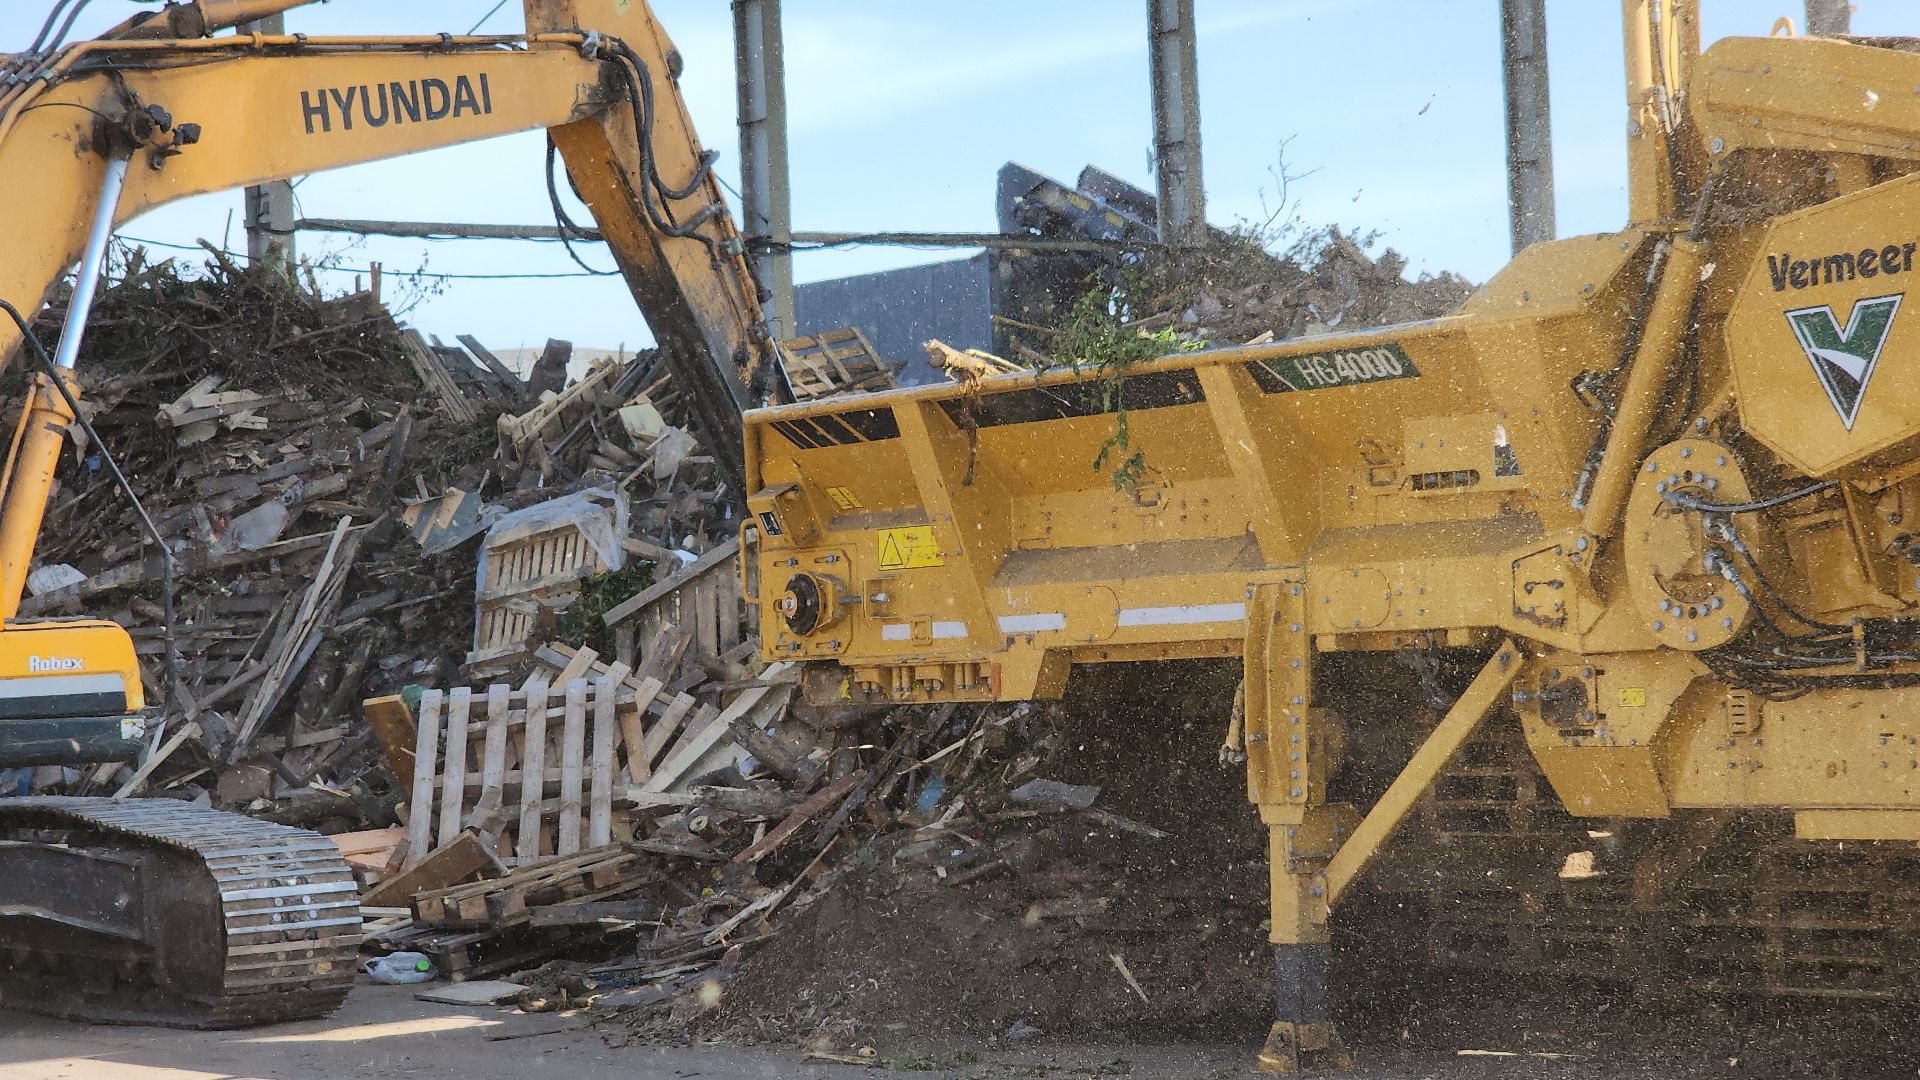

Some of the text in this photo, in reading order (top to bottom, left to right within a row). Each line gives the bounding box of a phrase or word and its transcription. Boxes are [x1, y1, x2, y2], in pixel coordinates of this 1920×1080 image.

[300, 72, 492, 135] HYUNDAI
[1766, 241, 1917, 292] Vermeer
[1293, 350, 1403, 386] HG4000
[28, 655, 85, 672] Robex
